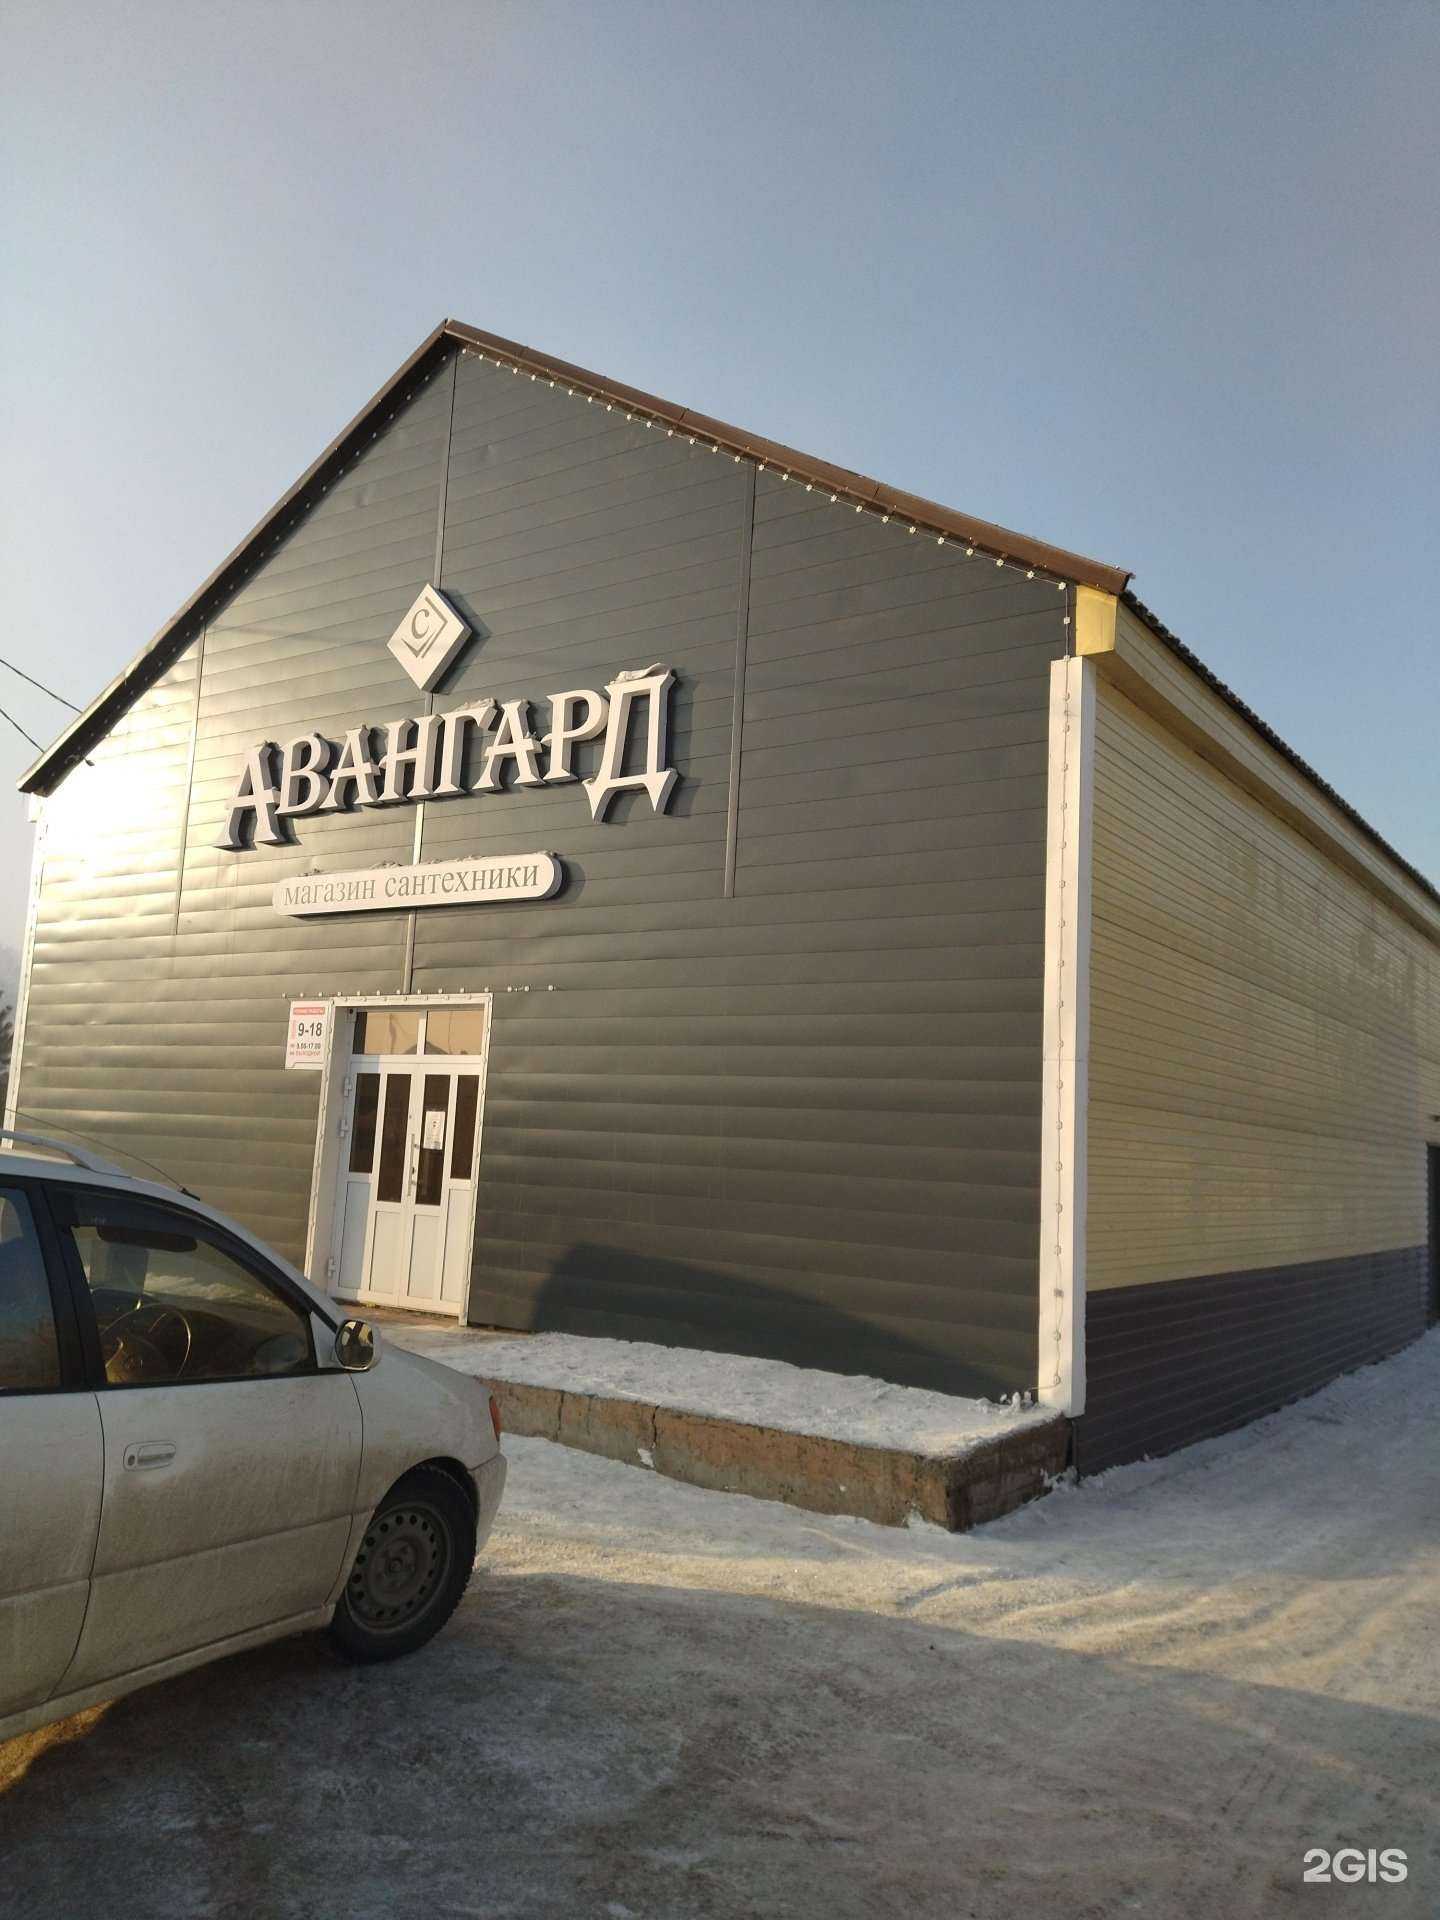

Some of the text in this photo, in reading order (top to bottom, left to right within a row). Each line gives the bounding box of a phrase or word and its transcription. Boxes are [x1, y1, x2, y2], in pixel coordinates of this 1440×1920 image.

[213, 668, 677, 849] АВАНГАРД
[284, 864, 539, 907] магазин сантехники
[298, 1022, 323, 1037] 9-18
